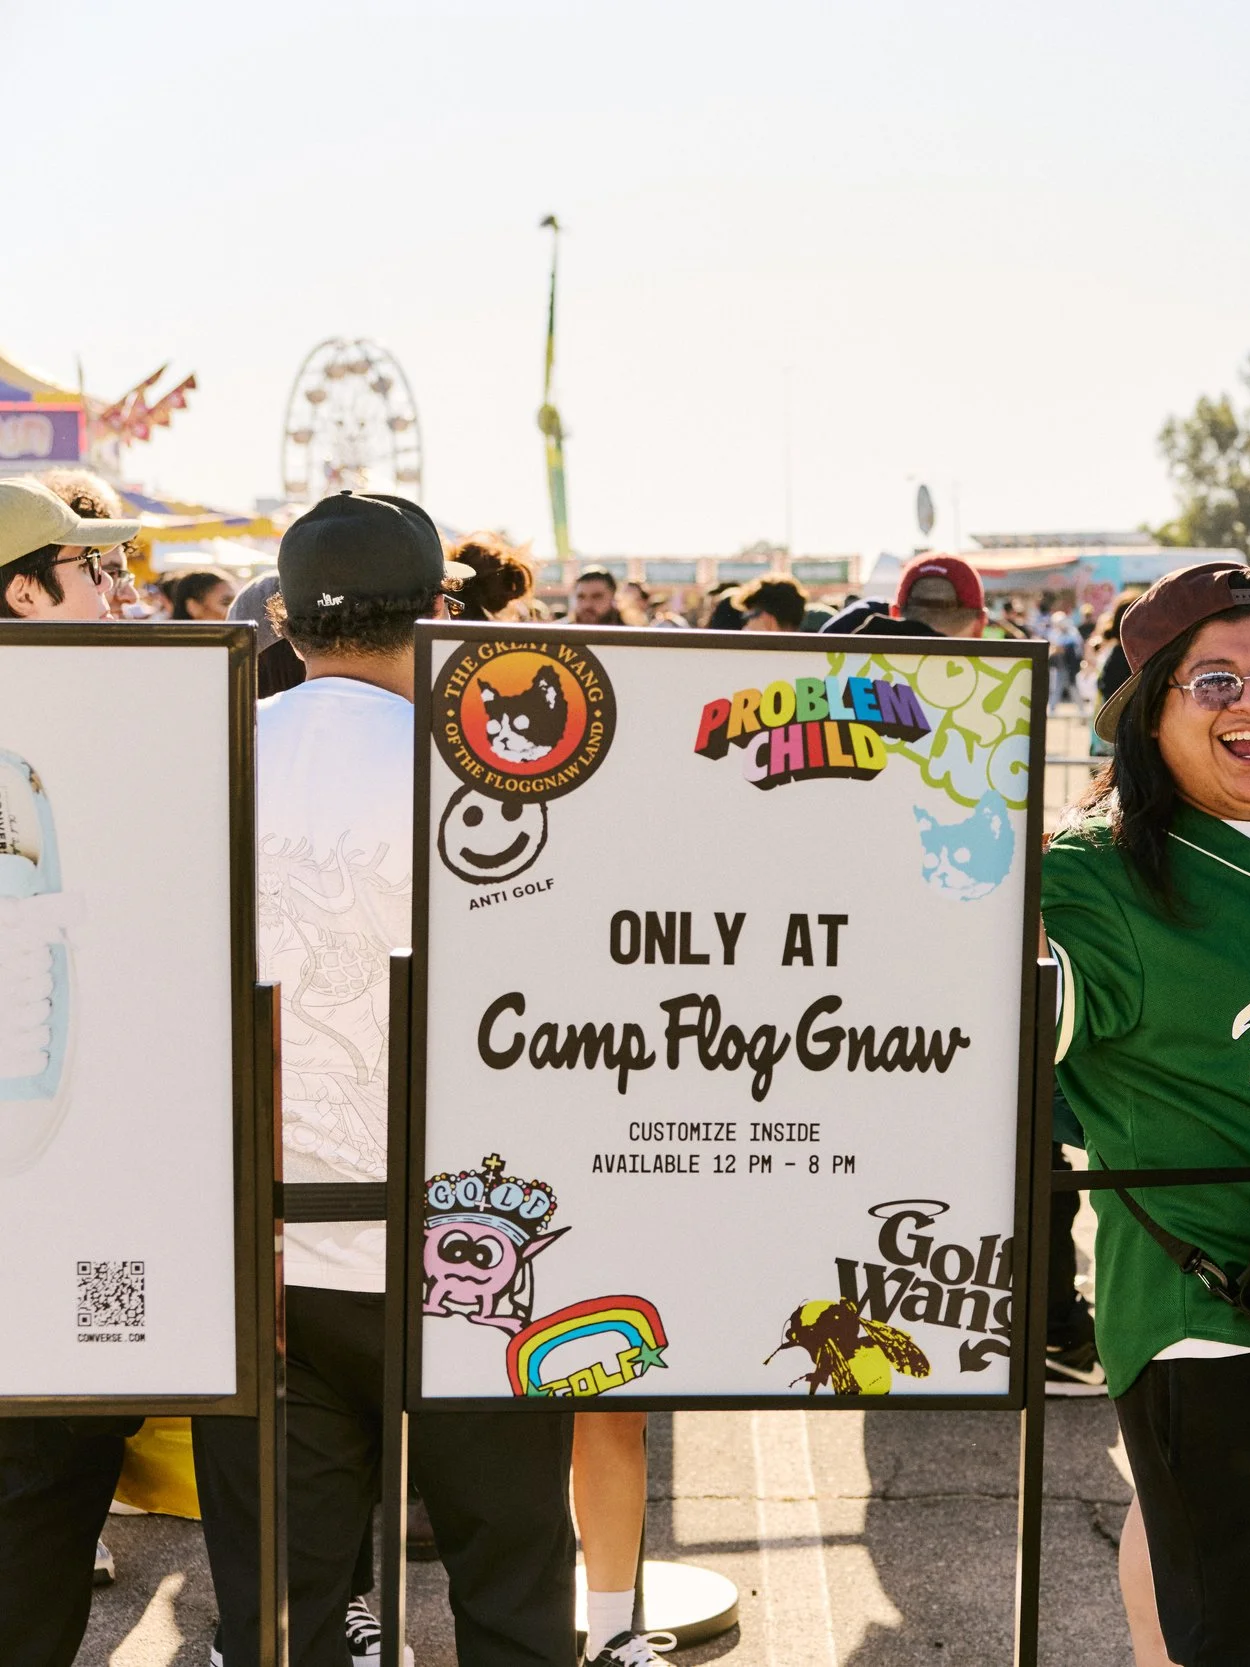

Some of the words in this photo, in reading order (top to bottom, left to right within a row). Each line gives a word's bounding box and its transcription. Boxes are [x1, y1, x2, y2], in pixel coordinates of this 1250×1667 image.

[444, 655, 478, 698] THE
[558, 644, 604, 703] WANG
[694, 676, 931, 759] PROBLEM
[445, 722, 461, 745] OF
[454, 745, 485, 778] THE
[484, 762, 581, 793] FLOGGNAW
[578, 721, 604, 767] LAND
[744, 721, 888, 790] CHILD
[469, 891, 508, 911] ANTI
[512, 878, 555, 898] GOLF
[609, 909, 747, 966] ONLY
[781, 913, 849, 967] AT
[477, 991, 656, 1095] Camp
[659, 992, 792, 1103] Flog
[795, 994, 972, 1075] Gnaw
[629, 1121, 737, 1142] CUSTOMIZE
[749, 1122, 821, 1142] INSIDE
[592, 1154, 700, 1174] AVAILABLE
[713, 1154, 736, 1174] 12
[749, 1154, 772, 1174] PM
[808, 1154, 820, 1174] 8
[832, 1155, 856, 1174] PM
[433, 1181, 546, 1215] GOLF
[77, 1333, 145, 1342] CONVERSE.COM
